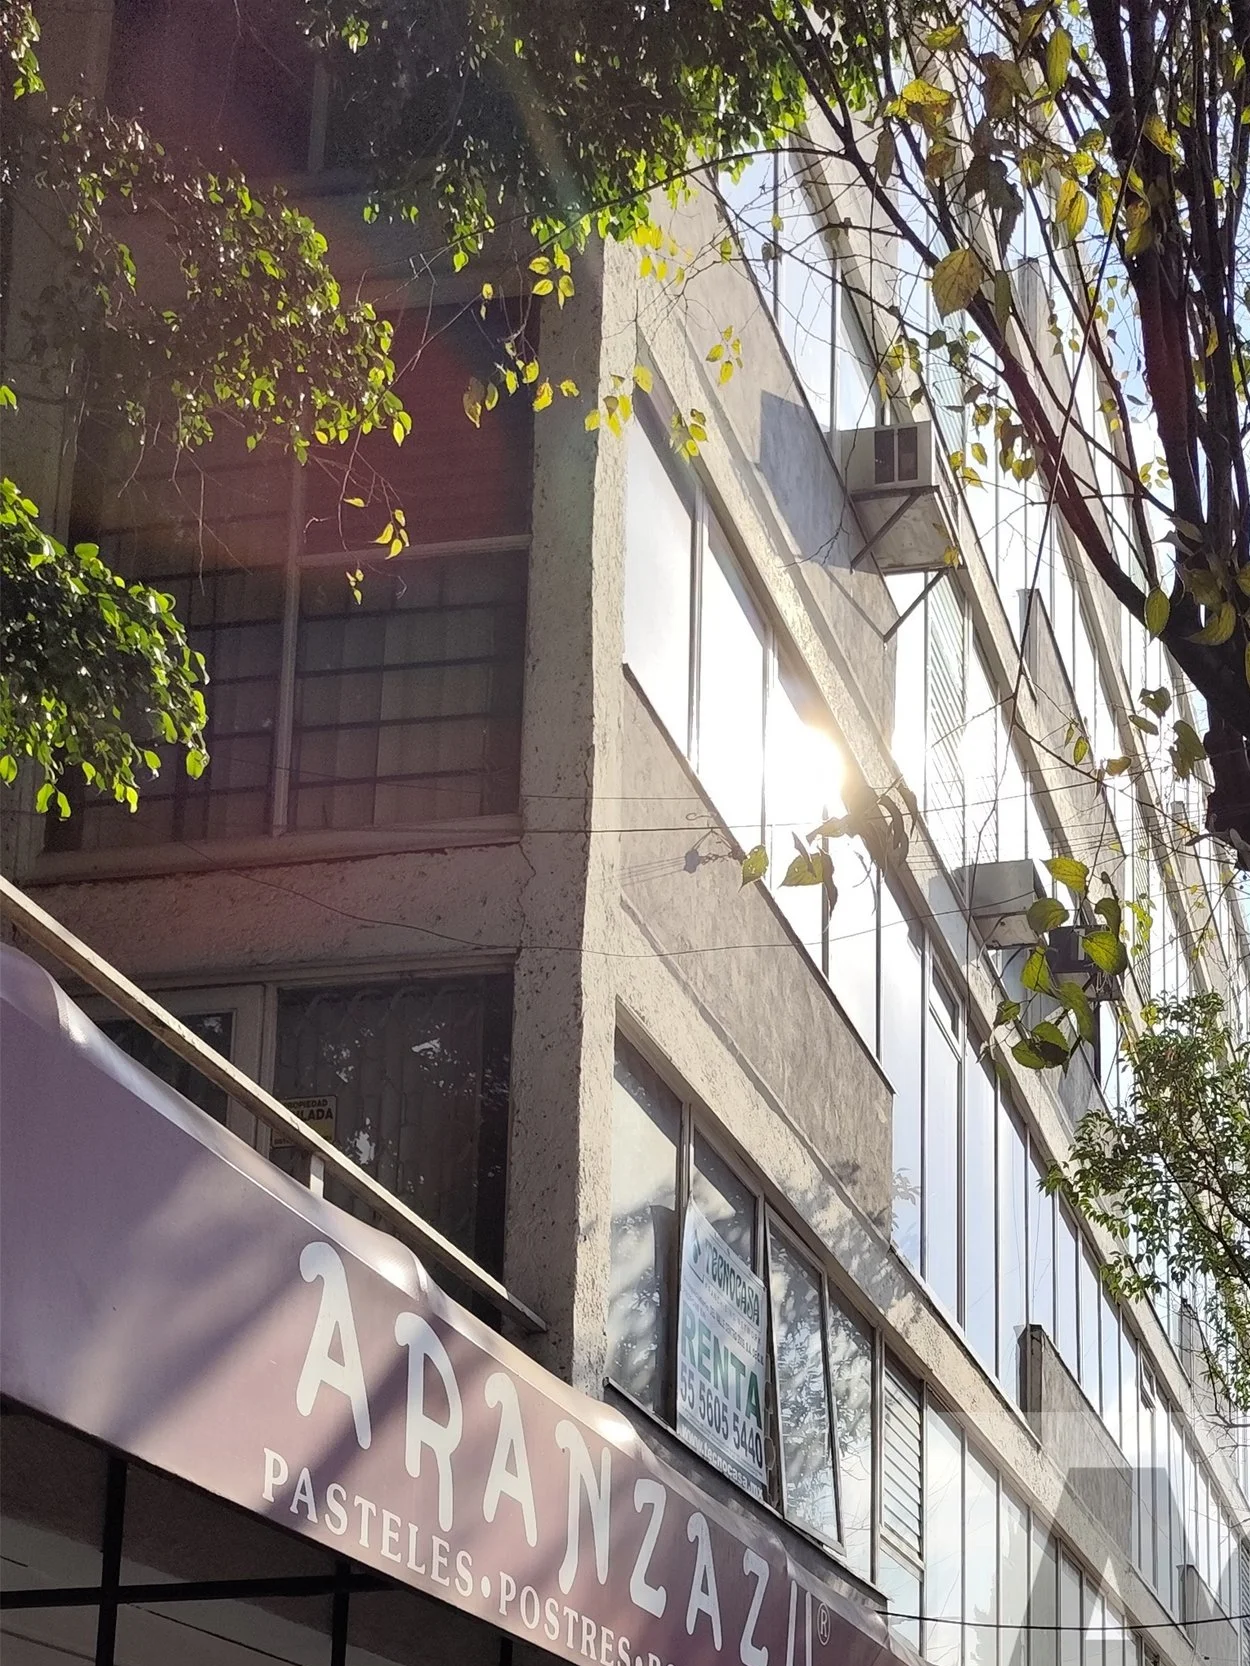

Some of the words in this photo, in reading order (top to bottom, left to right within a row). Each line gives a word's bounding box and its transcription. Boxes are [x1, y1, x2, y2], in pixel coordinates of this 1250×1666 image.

[704, 1241, 760, 1326] TECNOCASA
[680, 1361, 695, 1410] 55
[699, 1380, 729, 1440] 5605
[733, 1412, 763, 1469] 5440
[681, 1301, 763, 1430] RENTA
[679, 1423, 764, 1501] www.tecnocasa.mx
[262, 1447, 473, 1597] PASTELES
